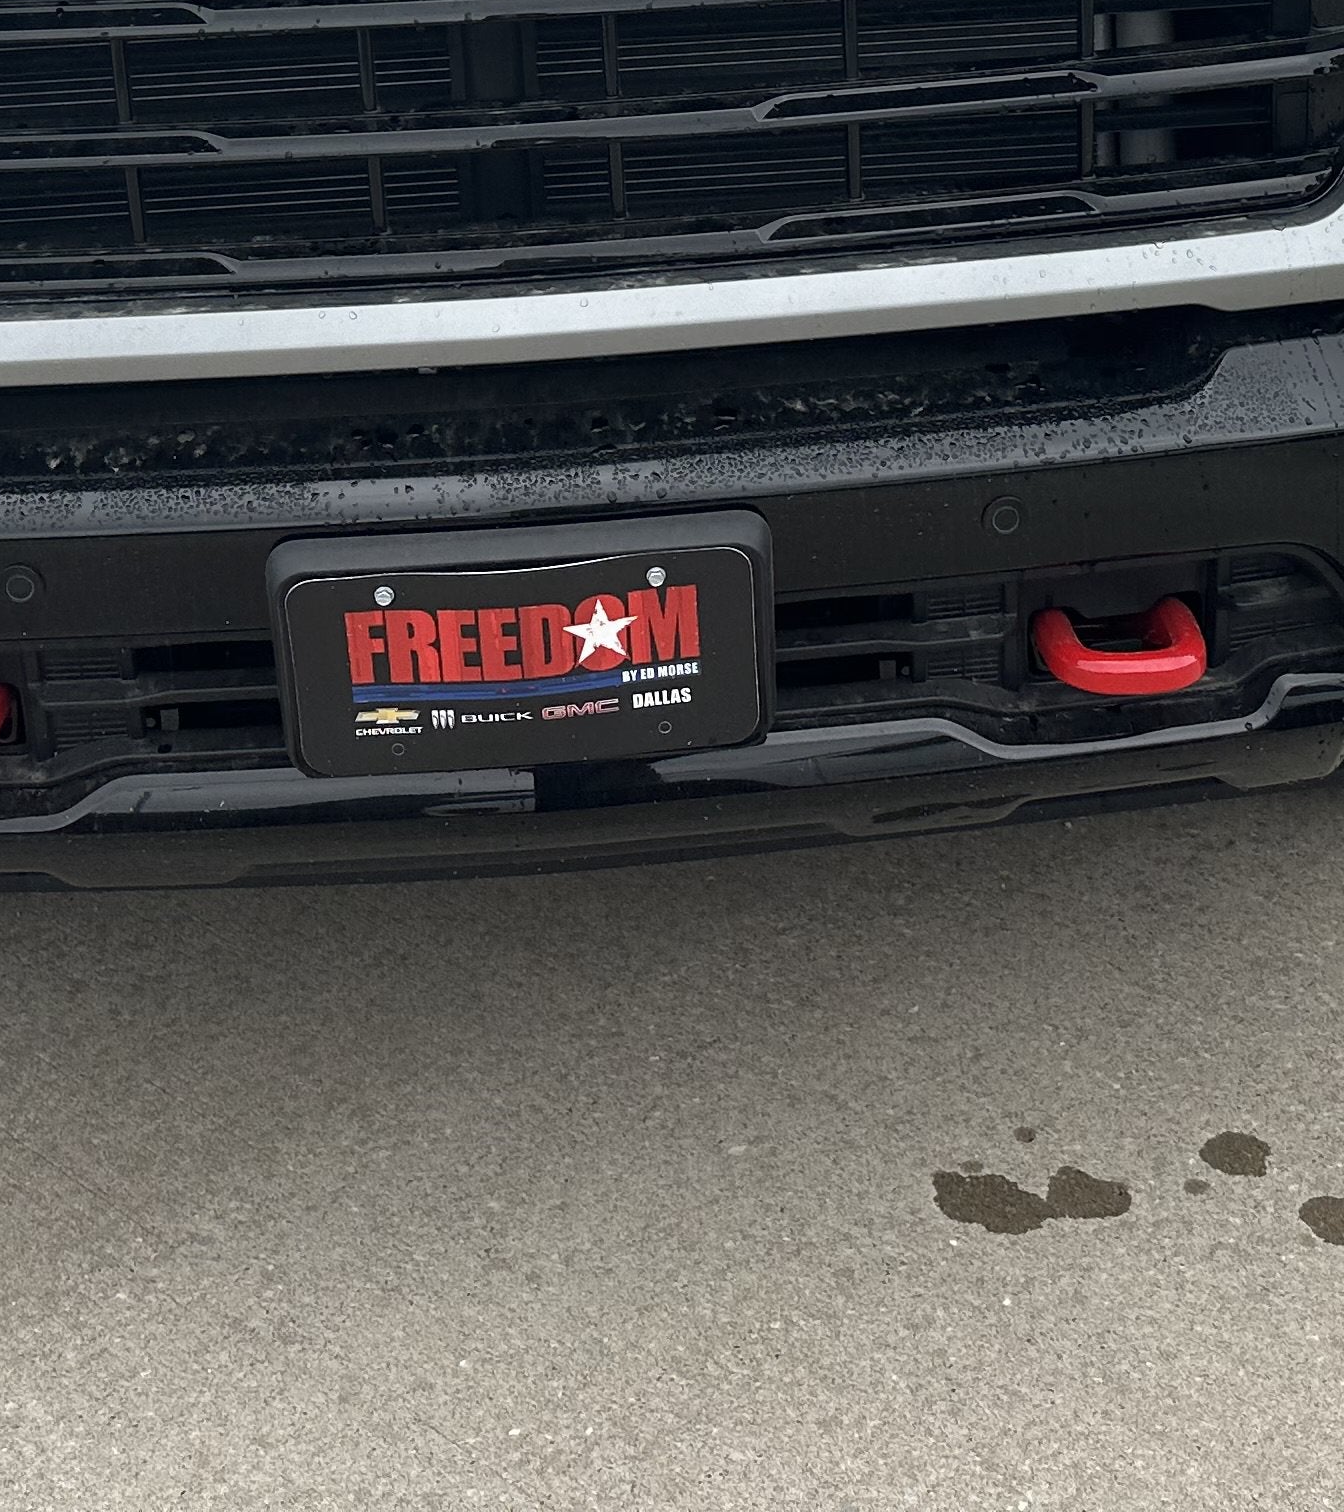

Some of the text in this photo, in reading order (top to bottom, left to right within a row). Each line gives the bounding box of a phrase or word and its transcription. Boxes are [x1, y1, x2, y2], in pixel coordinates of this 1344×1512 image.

[344, 584, 700, 684] FREEDOM
[622, 662, 699, 683] BY ED MORSE
[632, 687, 692, 709] DALLAS
[461, 711, 534, 724] BUICK
[541, 698, 619, 720] GMC
[355, 726, 424, 737] CHEVROLET
